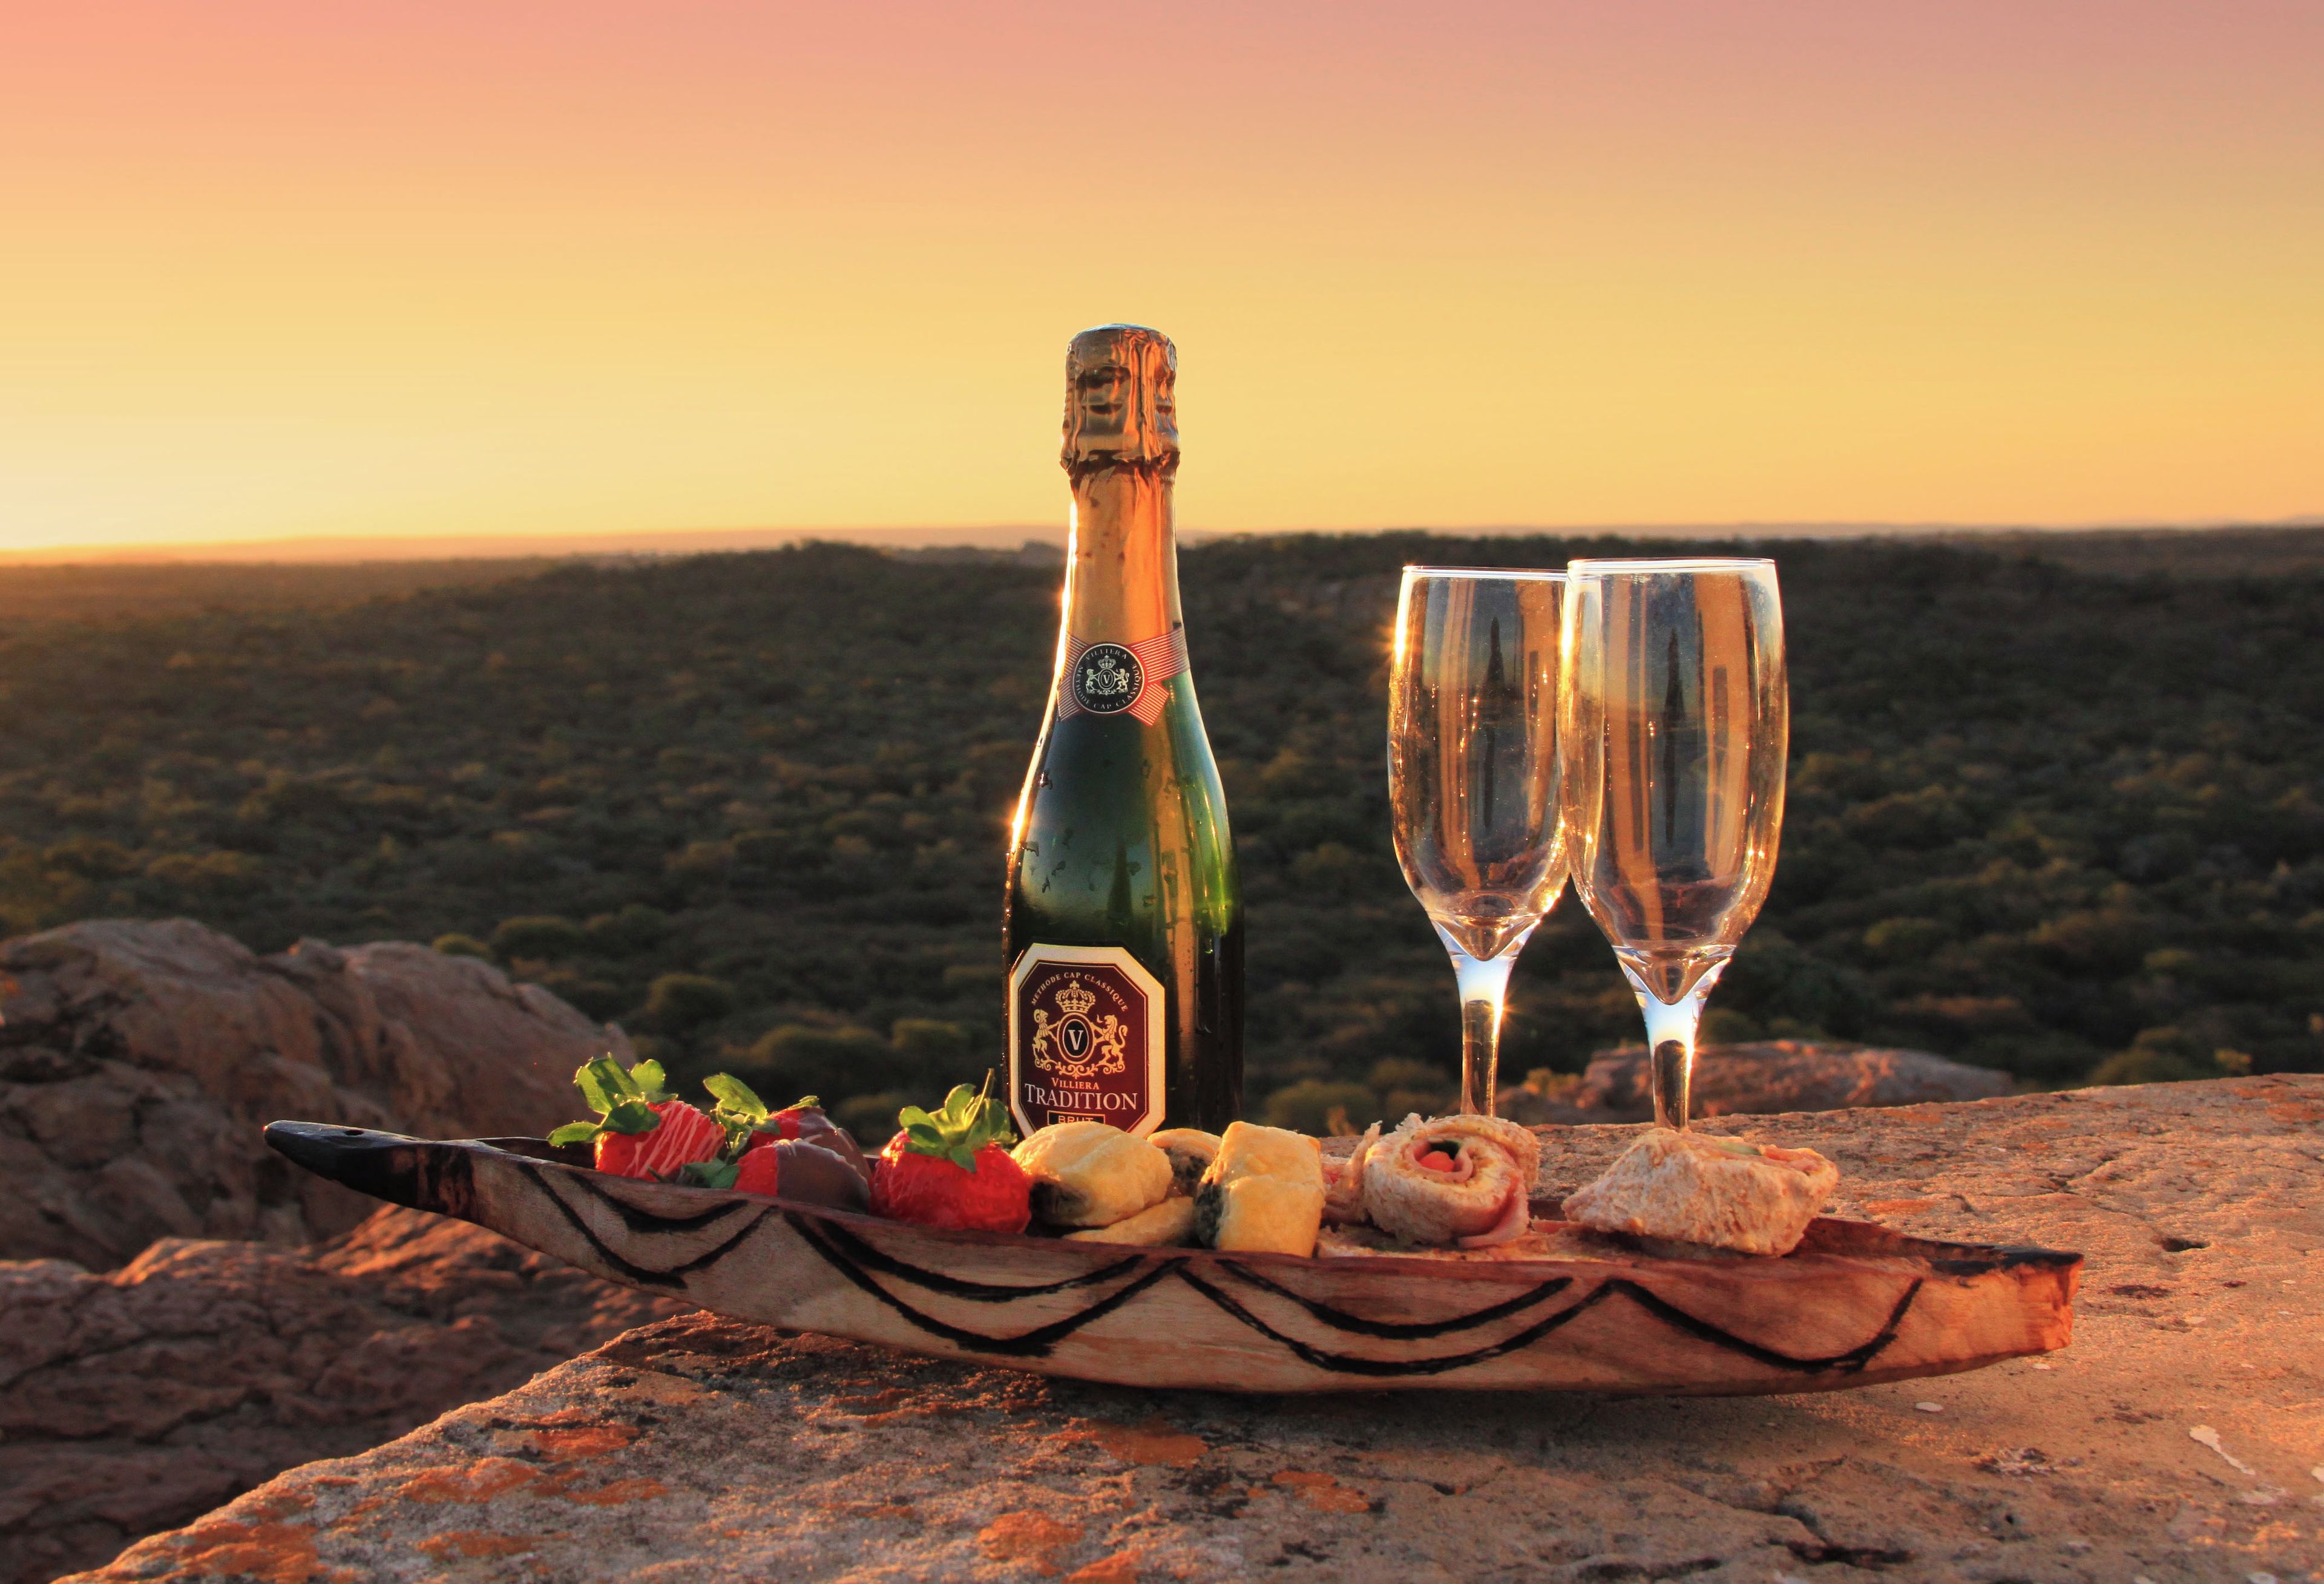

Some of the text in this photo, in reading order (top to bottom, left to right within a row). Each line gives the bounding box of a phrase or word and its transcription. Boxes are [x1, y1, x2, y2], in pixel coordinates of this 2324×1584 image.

[1086, 649, 1126, 660] VILLIERA
[1103, 675, 1111, 684] V
[1031, 974, 1061, 1006] METHODE
[1084, 974, 1129, 1012] CLASSIQUE
[1068, 1030, 1083, 1050] V
[1051, 1077, 1100, 1090] VILLIERA
[1024, 1082, 1138, 1110] TRADITION
